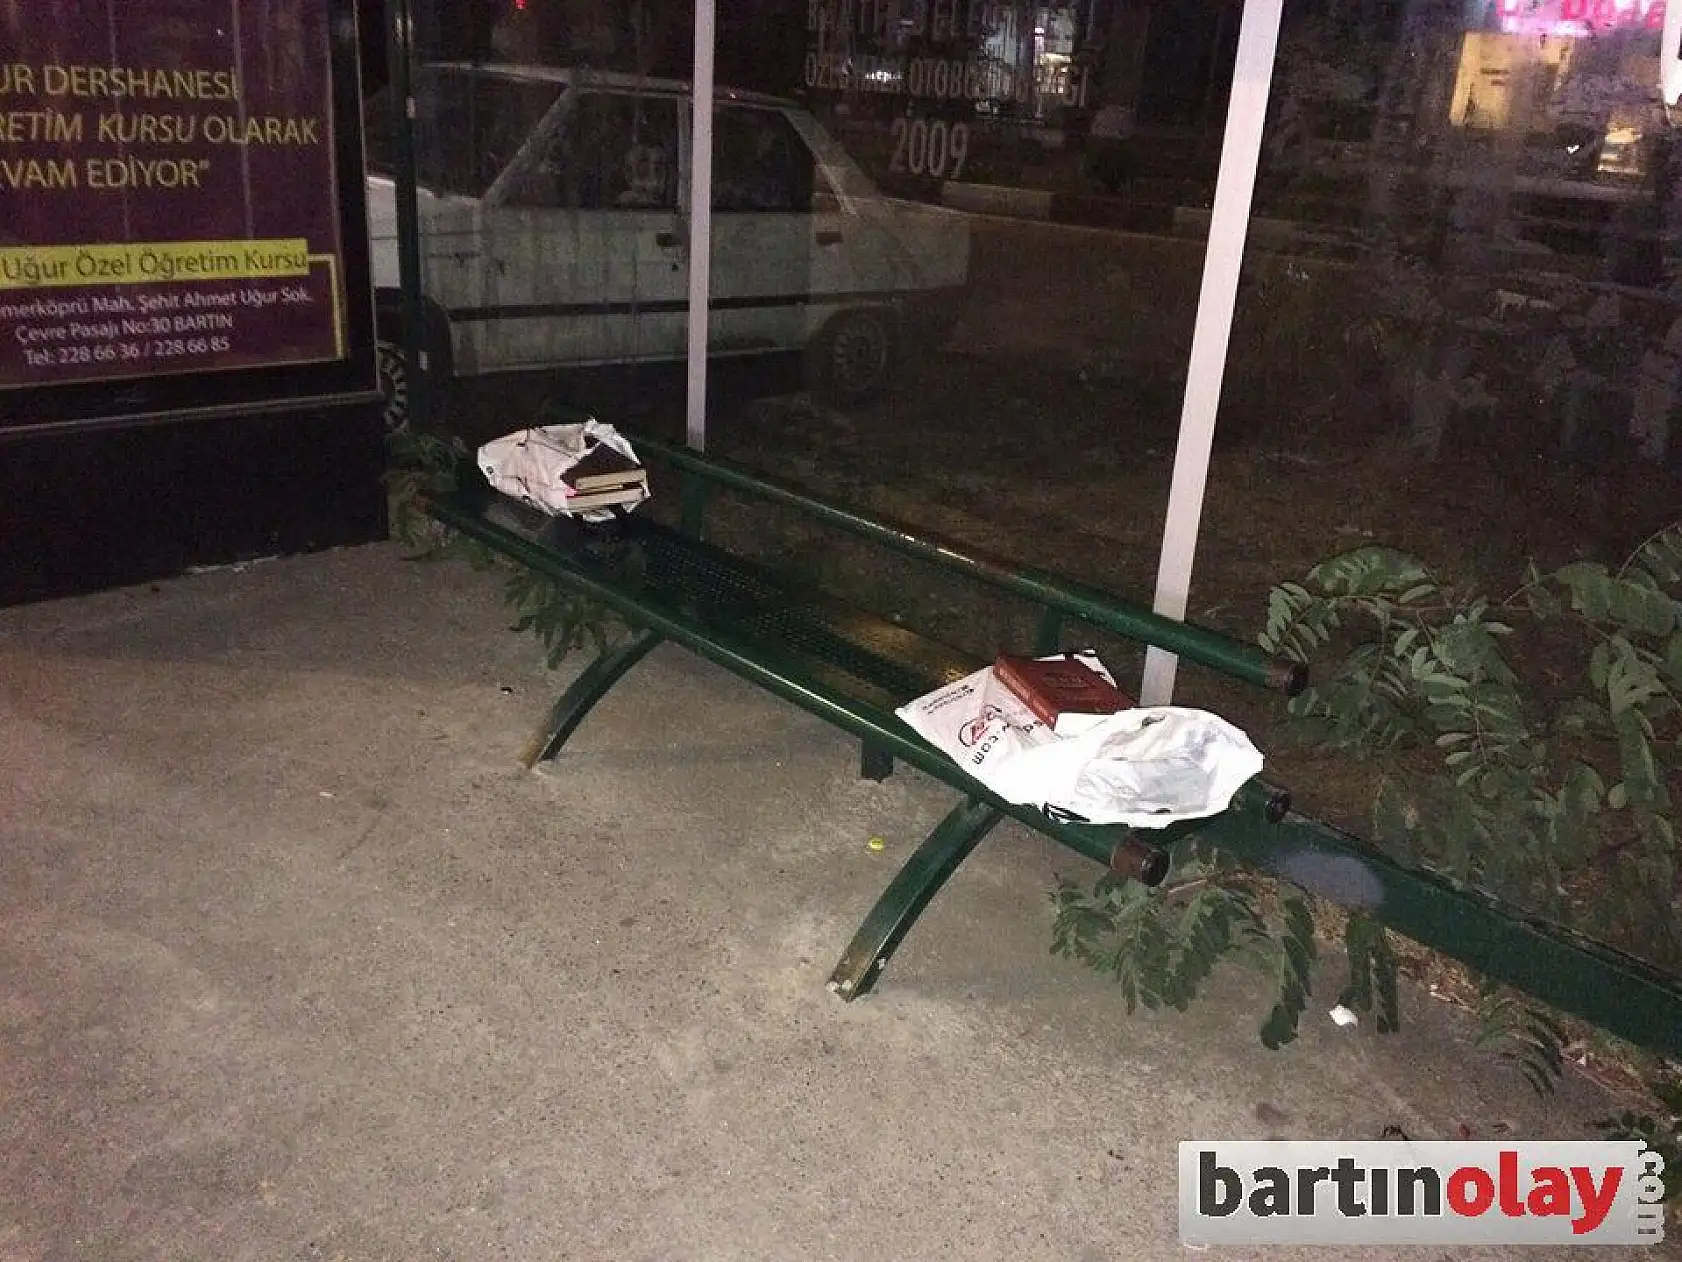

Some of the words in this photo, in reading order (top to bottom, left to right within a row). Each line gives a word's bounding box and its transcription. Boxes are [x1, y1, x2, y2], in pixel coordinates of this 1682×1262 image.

[44, 64, 239, 99] DERSHANESİ
[99, 112, 196, 143] KURSU
[203, 114, 320, 145] OLARAK
[890, 117, 969, 179] 2009
[3, 252, 67, 285] Uğur
[76, 247, 133, 278] Özel
[139, 247, 239, 281] Öğretim
[244, 248, 307, 271] Kursu
[183, 289, 237, 307] Ahmet
[174, 311, 235, 332] BARTIN
[59, 344, 91, 364] 228
[93, 343, 117, 361] 66
[154, 338, 186, 357] 228
[187, 337, 208, 354] 66
[210, 335, 231, 353] 85
